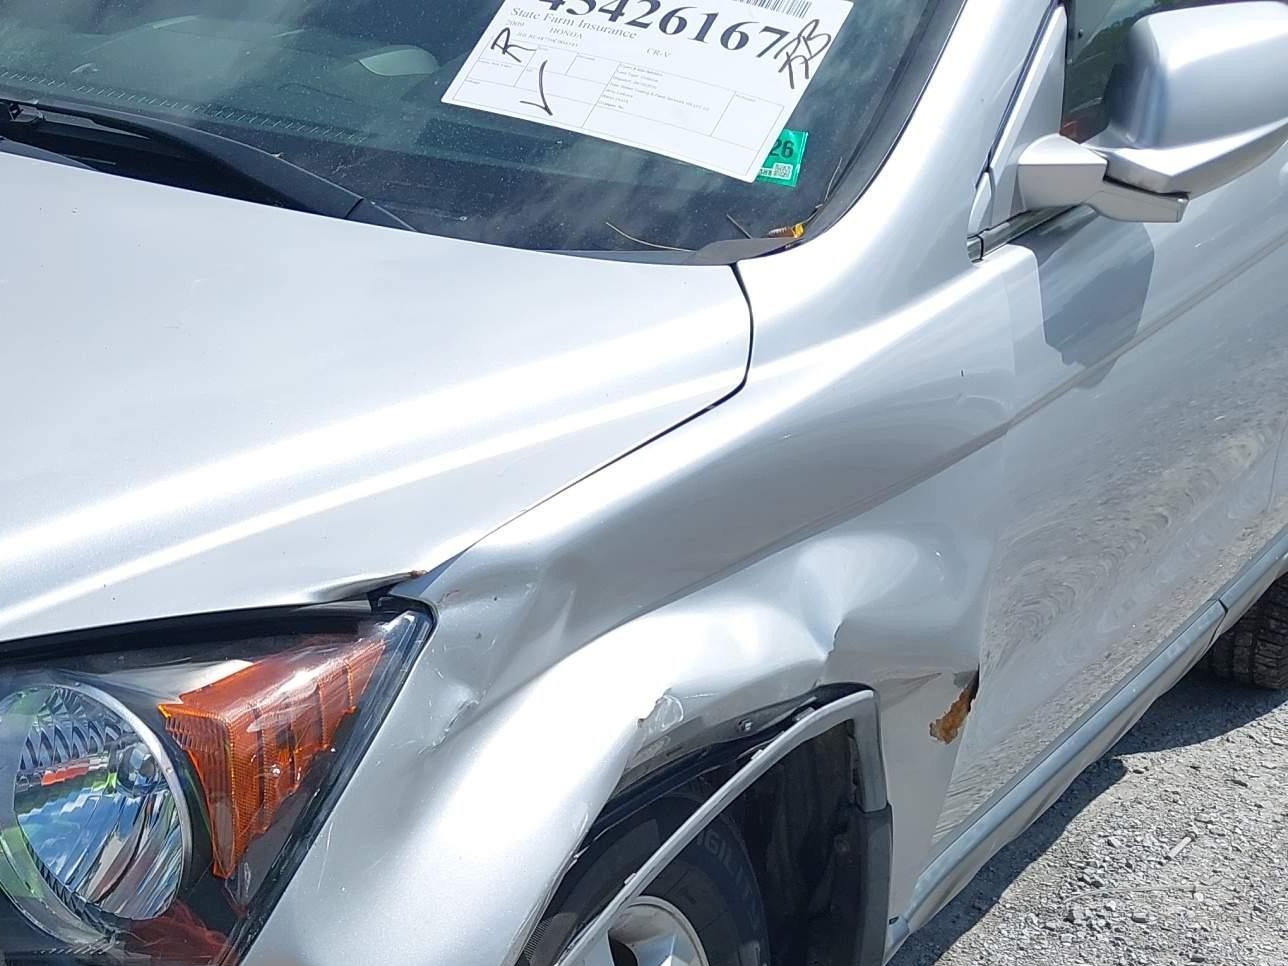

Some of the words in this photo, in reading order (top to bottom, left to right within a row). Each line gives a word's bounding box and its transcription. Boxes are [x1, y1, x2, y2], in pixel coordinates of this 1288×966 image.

[512, 7, 541, 20] State
[543, 12, 575, 27] Farm
[577, 18, 638, 40] Insurance
[768, 139, 796, 158] 26
